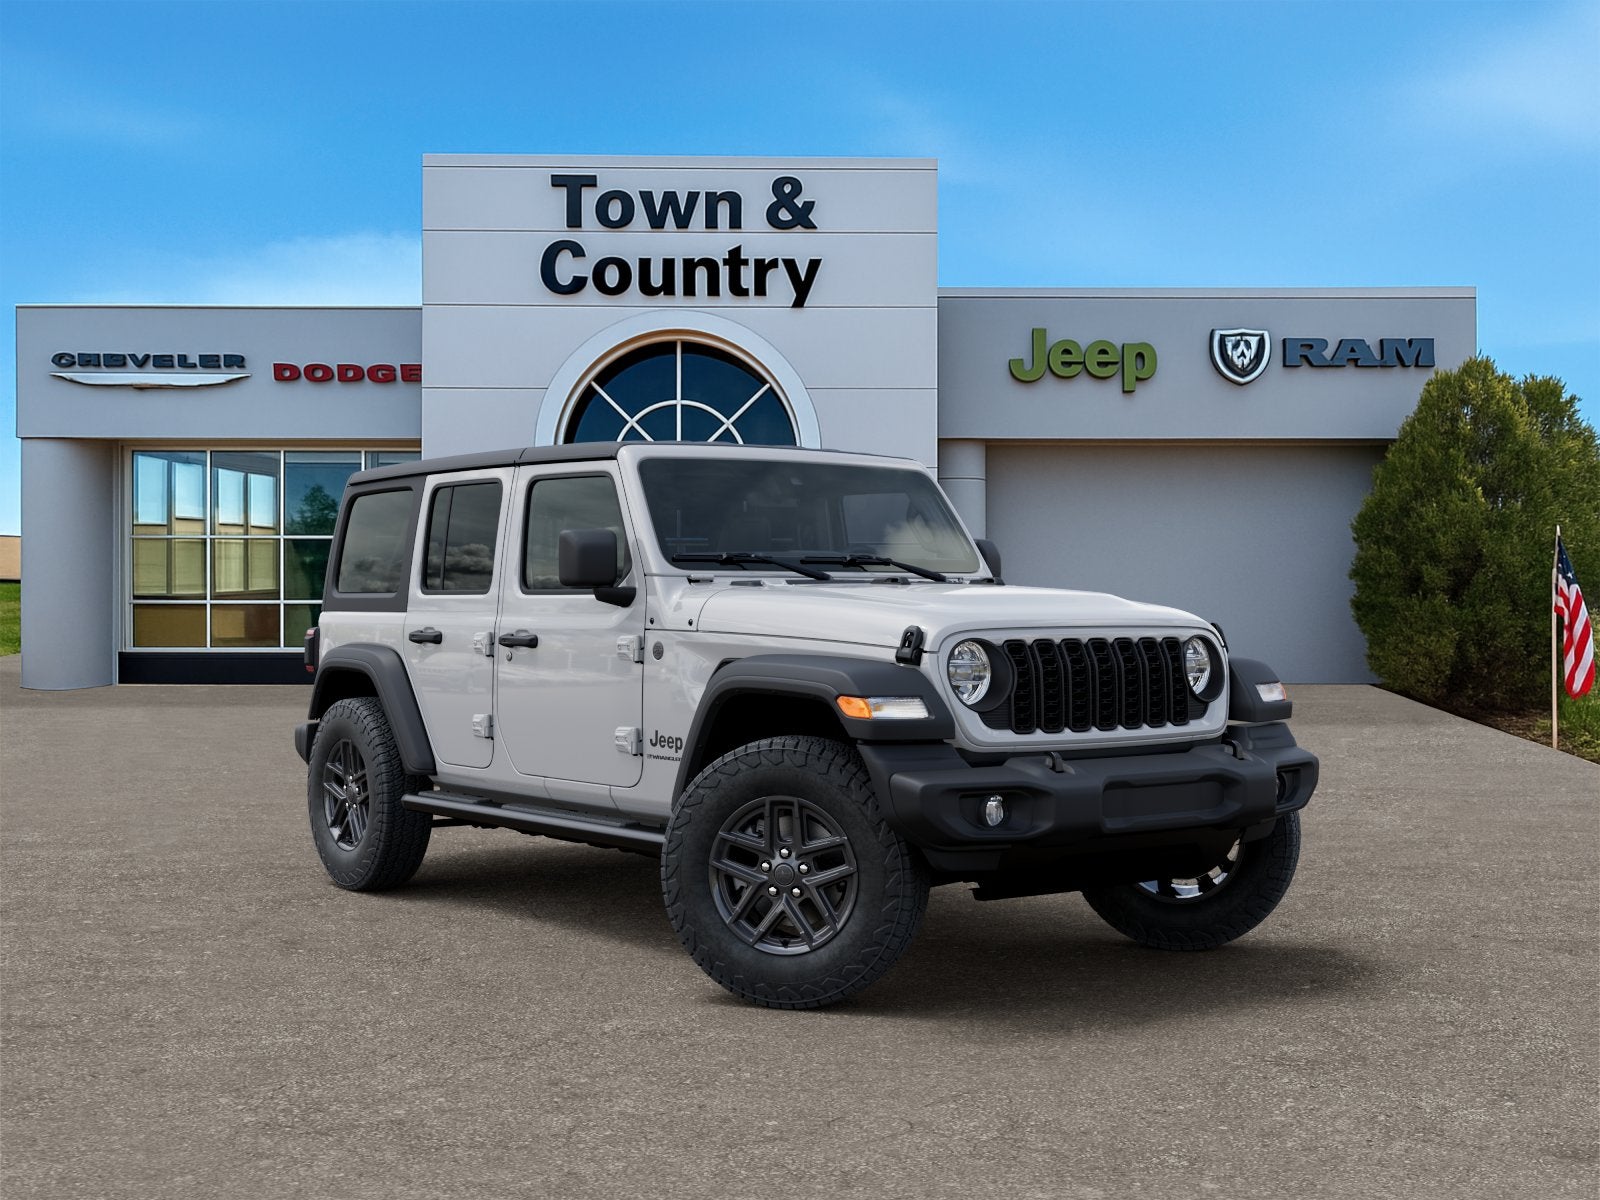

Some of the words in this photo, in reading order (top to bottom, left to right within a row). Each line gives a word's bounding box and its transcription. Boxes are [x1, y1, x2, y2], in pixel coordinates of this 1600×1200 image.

[551, 174, 742, 229] Town
[766, 176, 818, 229] &
[540, 239, 822, 308] Country
[273, 363, 422, 383] DODGE
[1009, 328, 1157, 393] Jeep
[1282, 338, 1435, 368] RAM
[649, 729, 683, 753] Jeep
